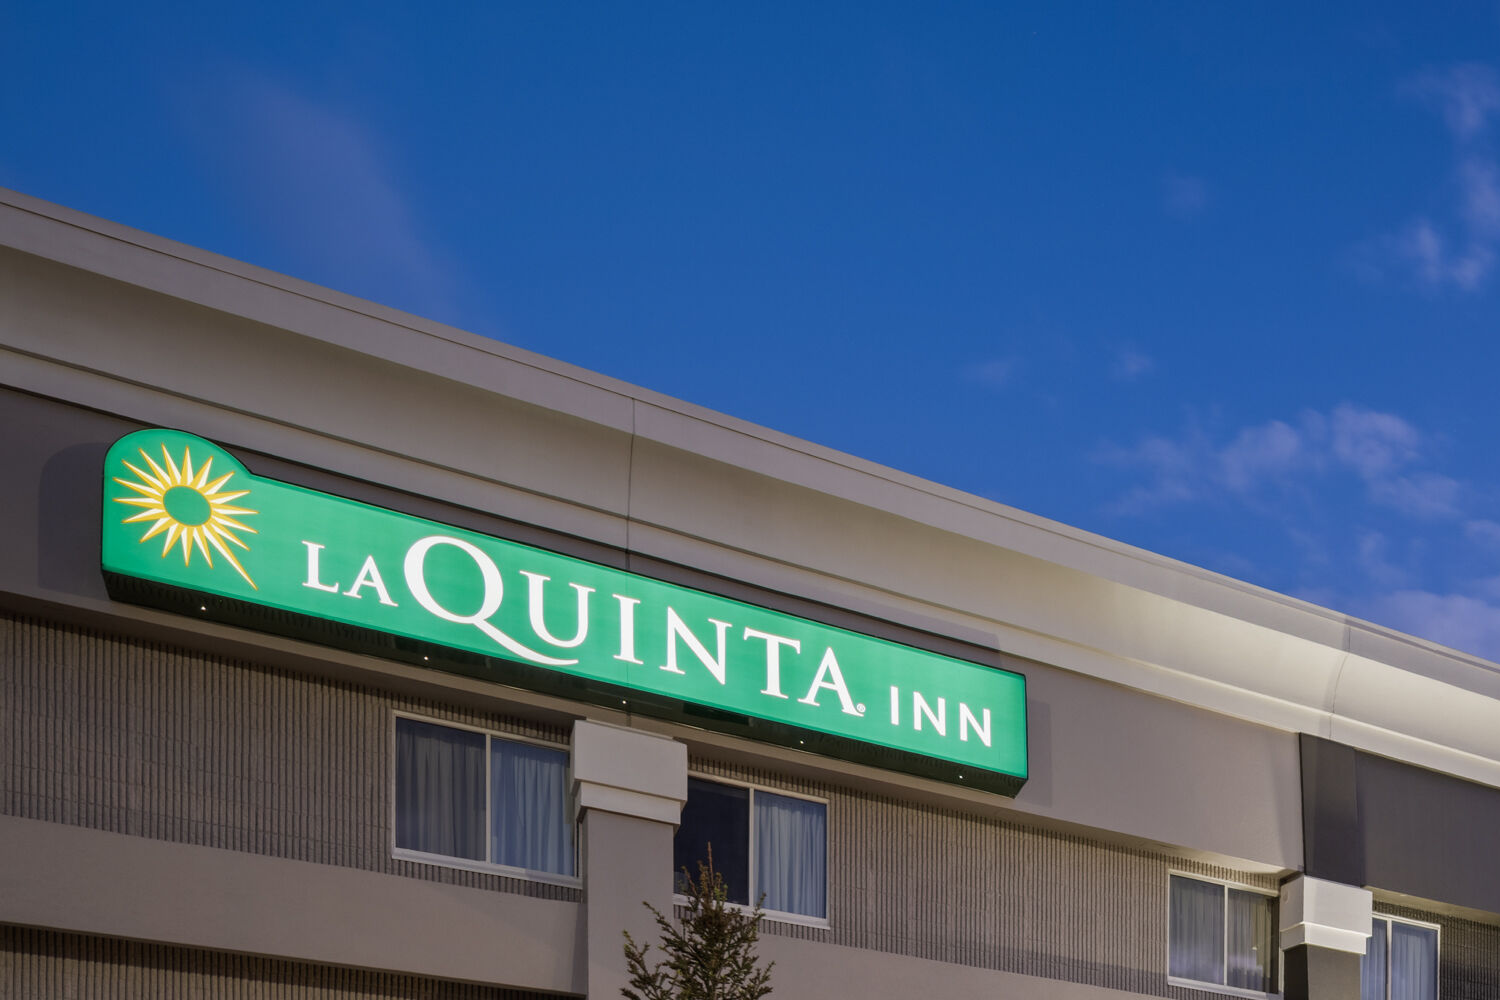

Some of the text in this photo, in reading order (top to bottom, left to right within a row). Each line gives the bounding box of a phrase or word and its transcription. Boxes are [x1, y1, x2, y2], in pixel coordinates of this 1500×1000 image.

[302, 535, 992, 748] LA QUINTA INN
